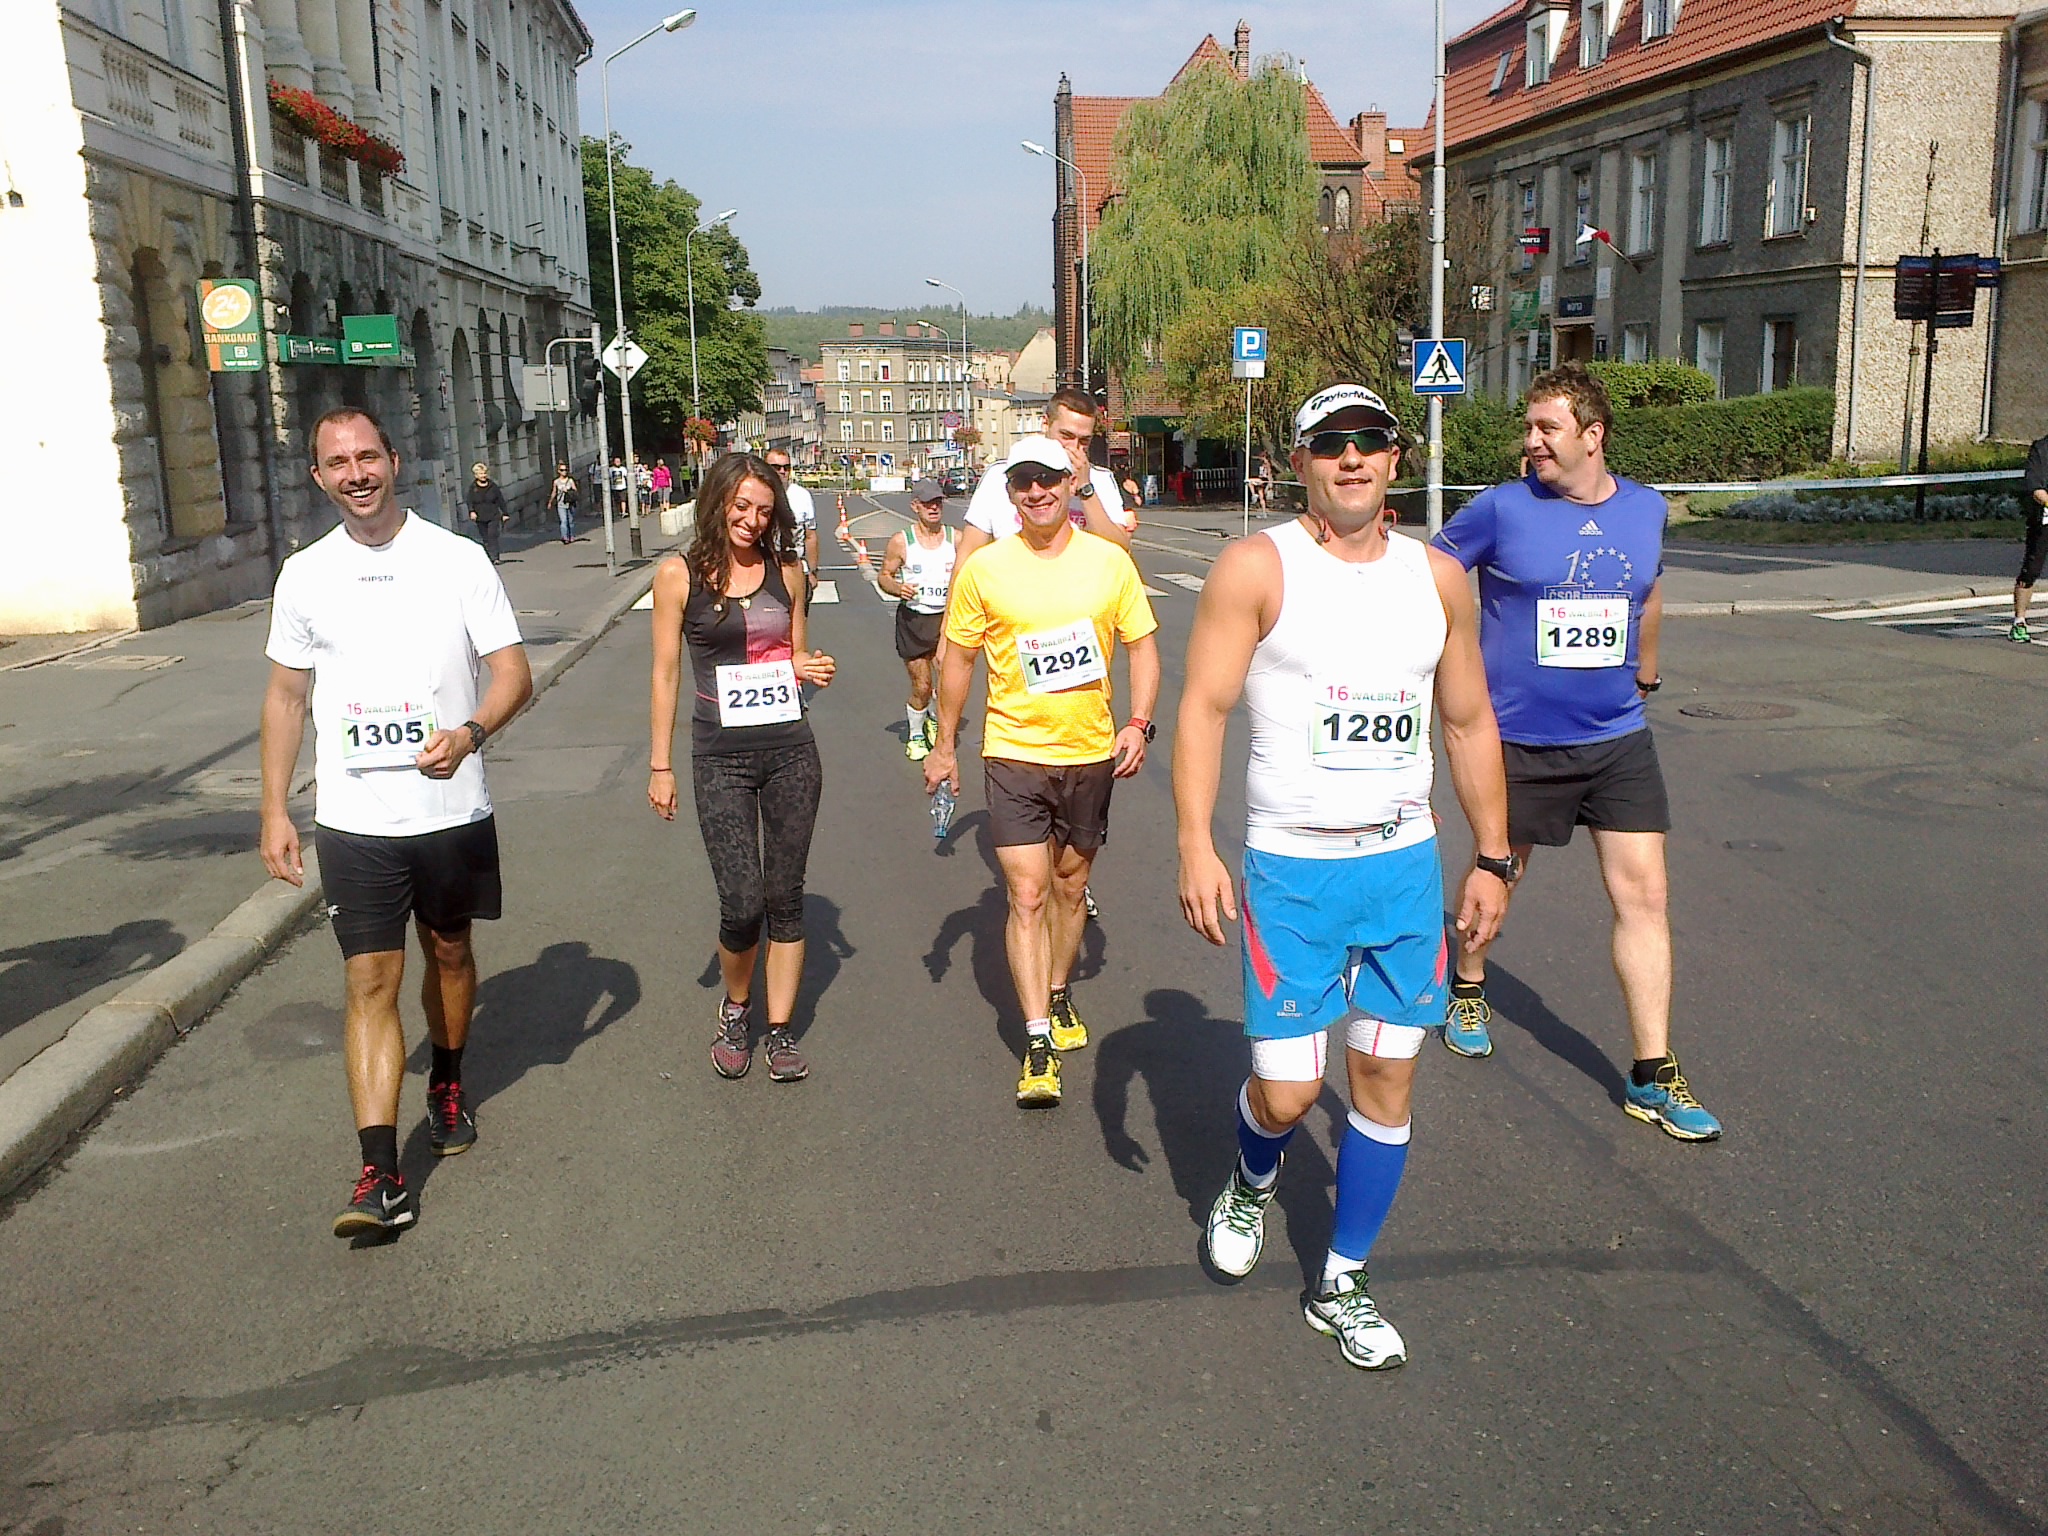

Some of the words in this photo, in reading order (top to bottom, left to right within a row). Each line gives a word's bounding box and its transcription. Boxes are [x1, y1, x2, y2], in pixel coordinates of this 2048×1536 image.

[211, 294, 241, 319] 24
[203, 333, 258, 343] BANKOMAT
[1241, 331, 1260, 357] P
[919, 586, 949, 597] 1302
[1549, 606, 1567, 619] 16
[1024, 639, 1040, 651] 16
[1547, 626, 1617, 648] 1289
[1028, 645, 1093, 676] 1292
[728, 670, 743, 682] 16
[727, 685, 790, 709] 2253
[1326, 686, 1349, 701] 16
[346, 702, 362, 715] 16
[347, 721, 424, 747] 1305
[1323, 713, 1413, 742] 1280
